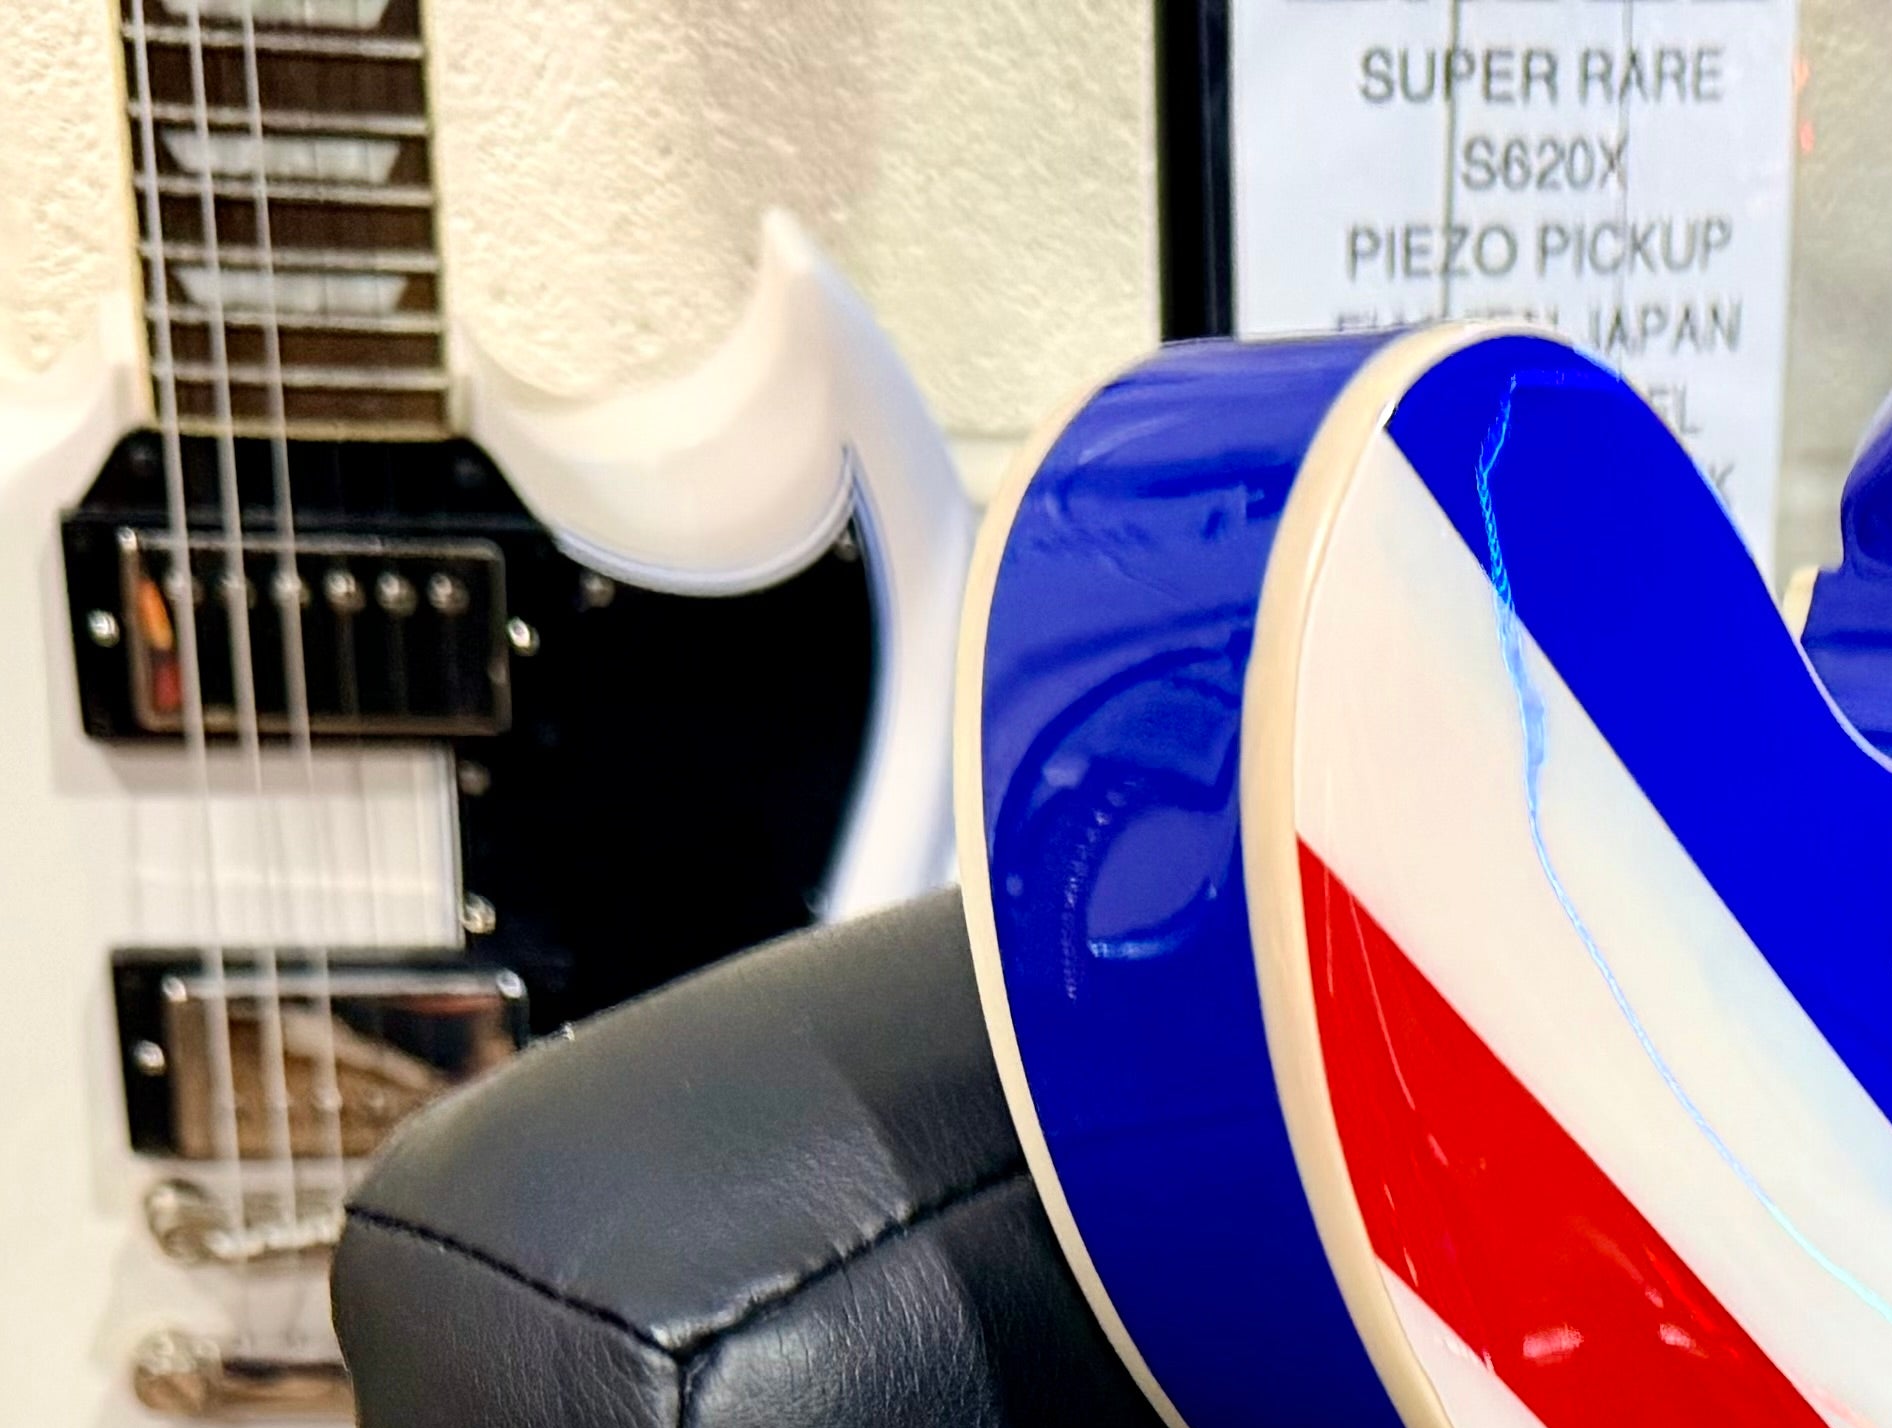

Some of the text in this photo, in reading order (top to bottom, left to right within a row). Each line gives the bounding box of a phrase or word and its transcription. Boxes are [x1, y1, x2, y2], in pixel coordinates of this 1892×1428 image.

[1358, 45, 1726, 104] SUPER RARE
[1460, 133, 1631, 192] S620X
[1346, 216, 1733, 281] PIEZO PICKUP
[1588, 301, 1742, 355] JAPAN
